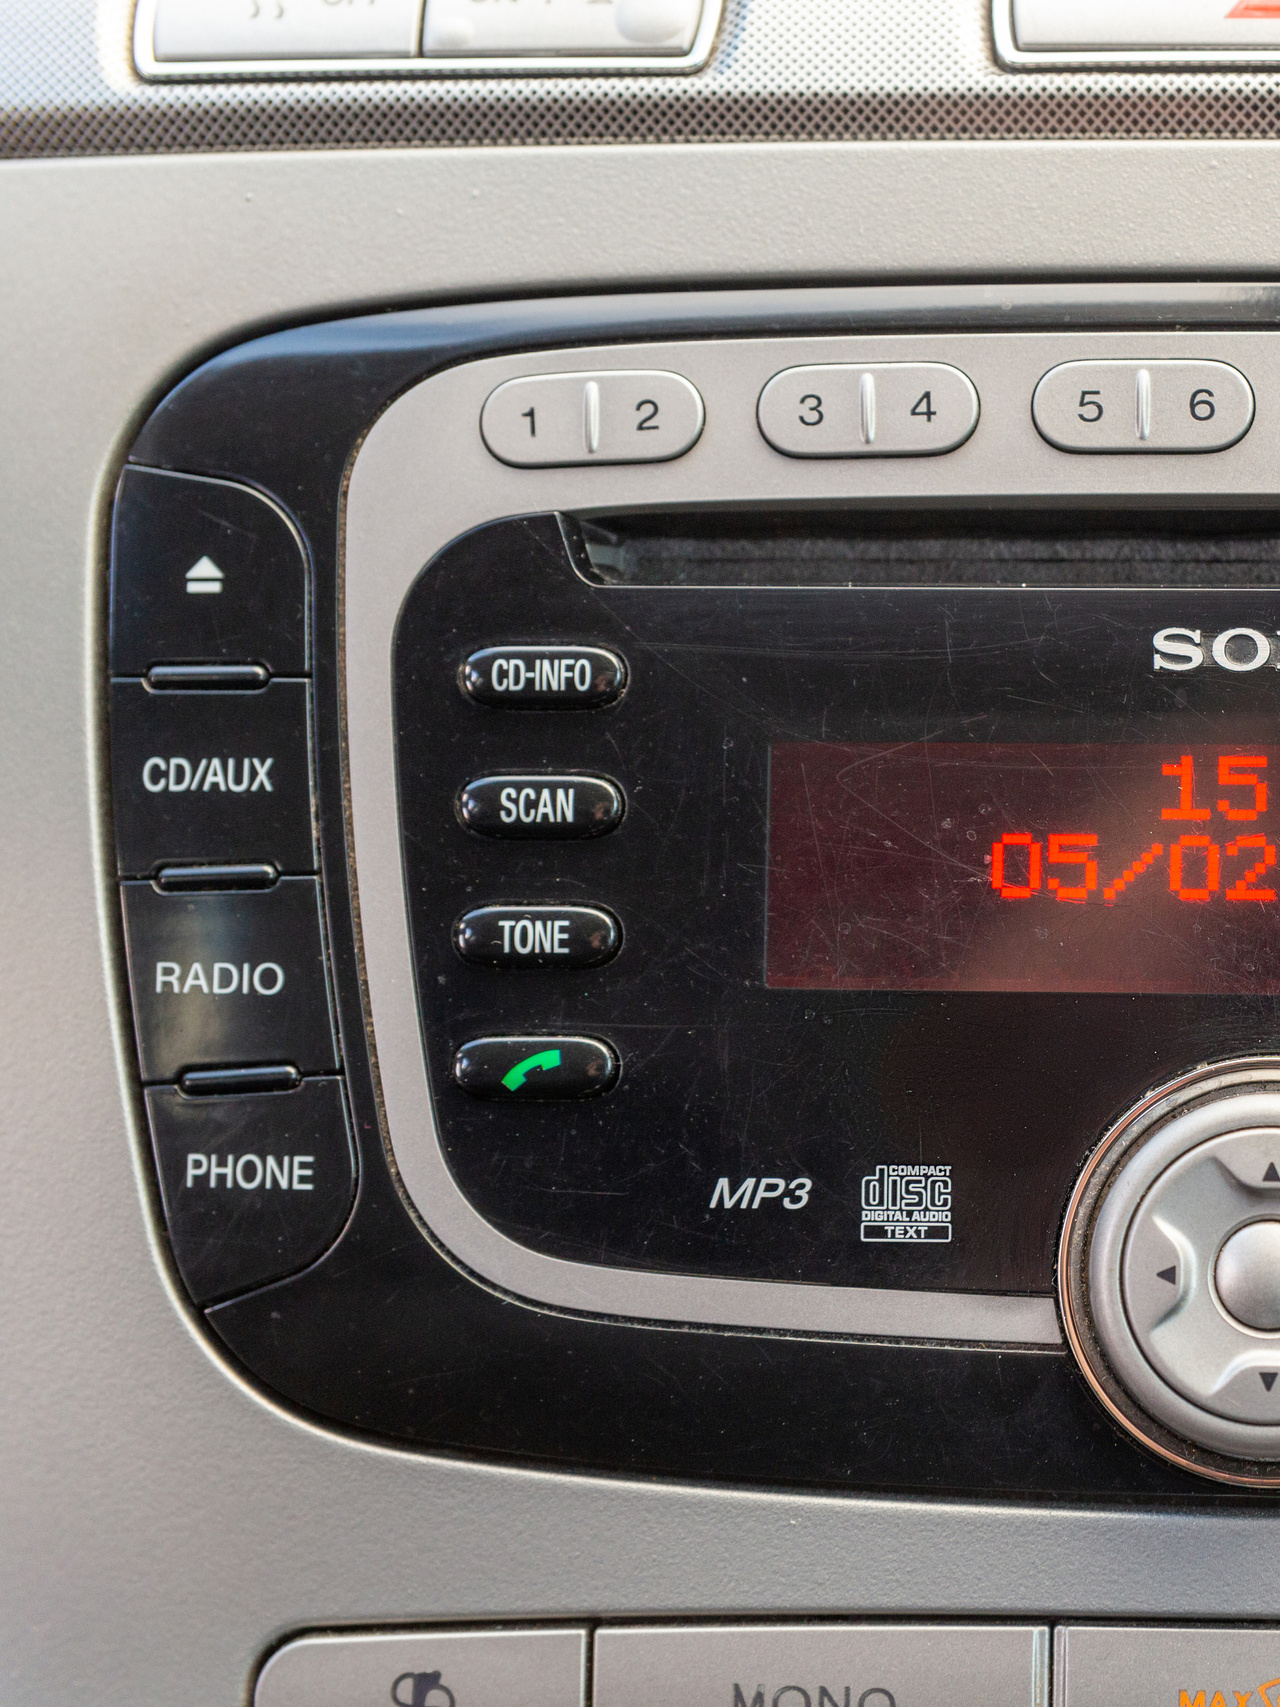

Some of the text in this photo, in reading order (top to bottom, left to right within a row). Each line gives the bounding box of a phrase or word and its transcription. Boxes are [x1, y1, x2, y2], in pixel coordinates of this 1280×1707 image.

[520, 399, 661, 438] 1 2
[797, 390, 938, 427] 3 4
[1077, 388, 1218, 423] 5 6
[491, 658, 593, 692] CD-INFO
[141, 756, 275, 793] CD/AUX
[499, 786, 575, 824] SCAN
[497, 918, 571, 955] TONE
[154, 961, 286, 996] RADIO
[185, 1152, 316, 1191] PHONE
[888, 1165, 952, 1176] COMPACT
[708, 1176, 813, 1210] MP3
[861, 1210, 952, 1222] DIGITAL AUDIO
[884, 1225, 929, 1239] TEXT
